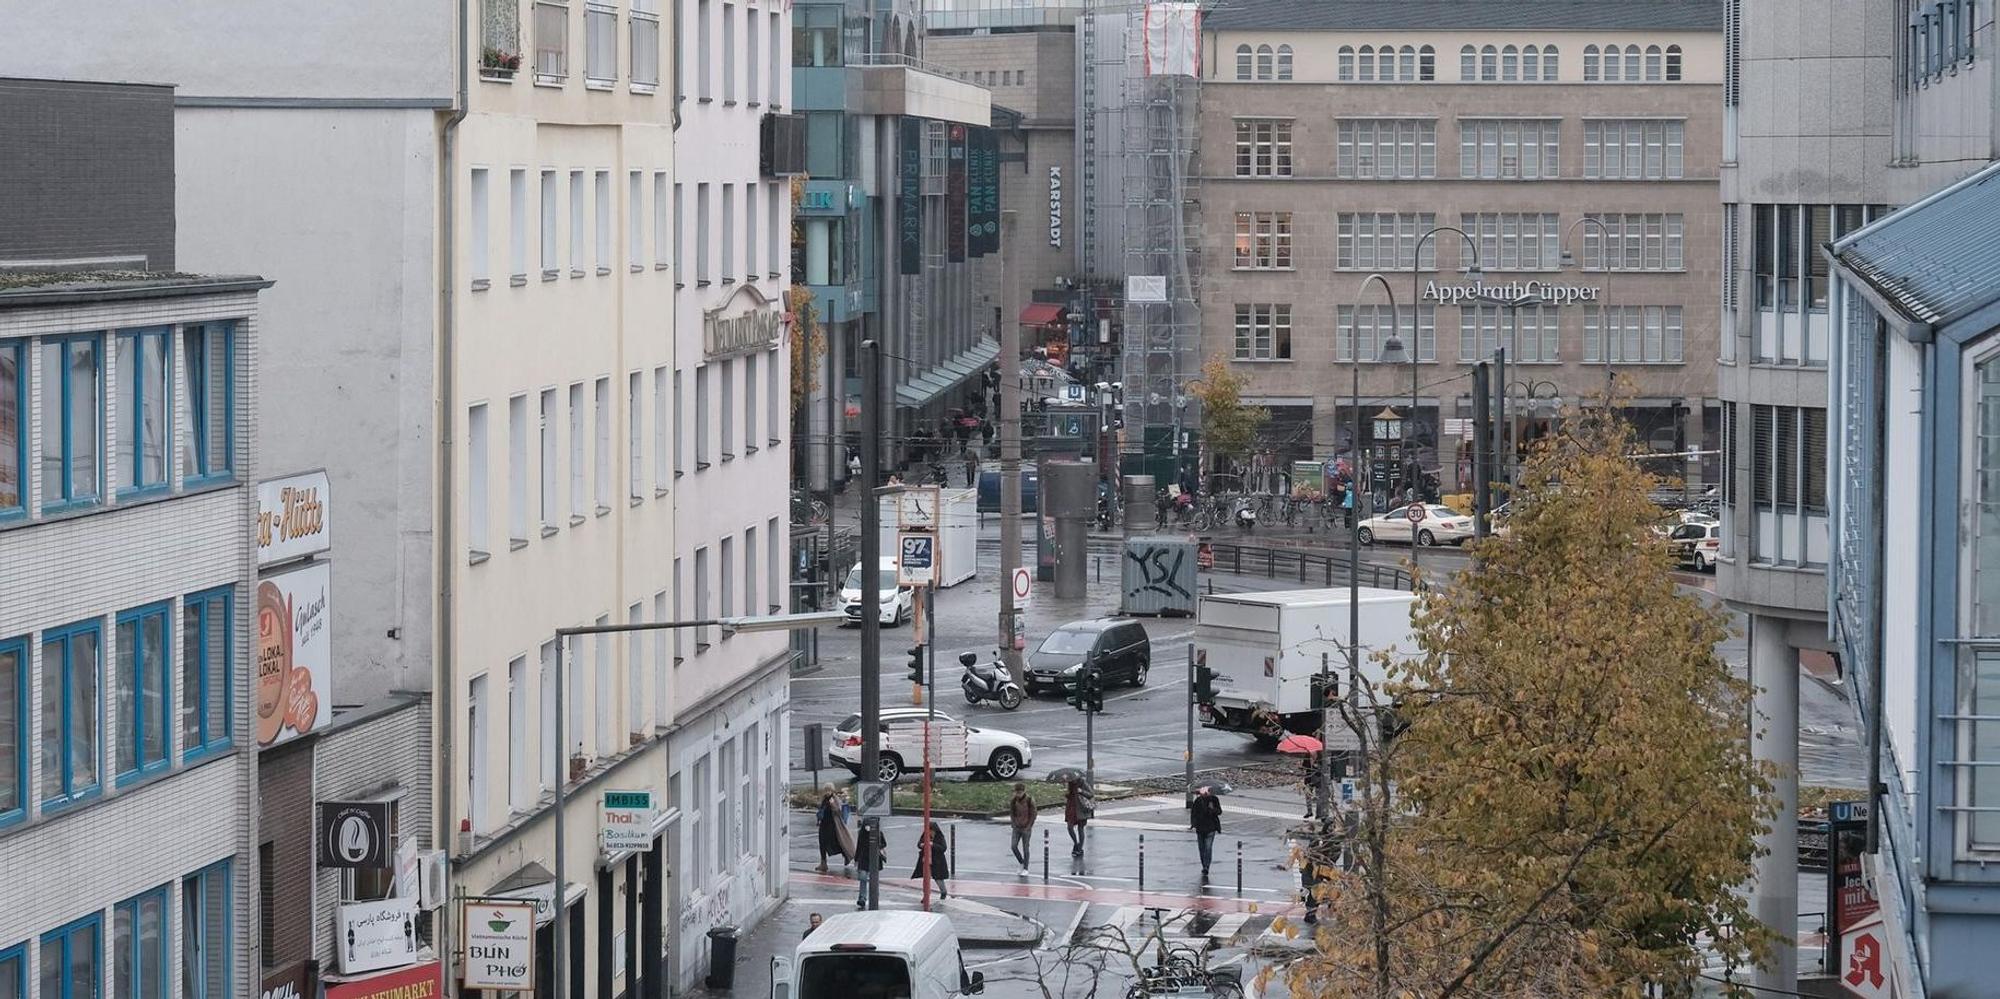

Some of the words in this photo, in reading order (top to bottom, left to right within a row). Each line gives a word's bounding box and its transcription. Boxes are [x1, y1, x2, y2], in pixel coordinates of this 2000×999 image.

[903, 150, 919, 242] PRIMARK
[1050, 166, 1061, 248] KARSTADT
[1410, 508, 1421, 517] 30
[1127, 546, 1191, 600] YSL
[606, 794, 649, 806] IMBISS
[605, 811, 633, 824] Thai
[1836, 803, 1850, 820] U
[469, 942, 510, 960] BÚN
